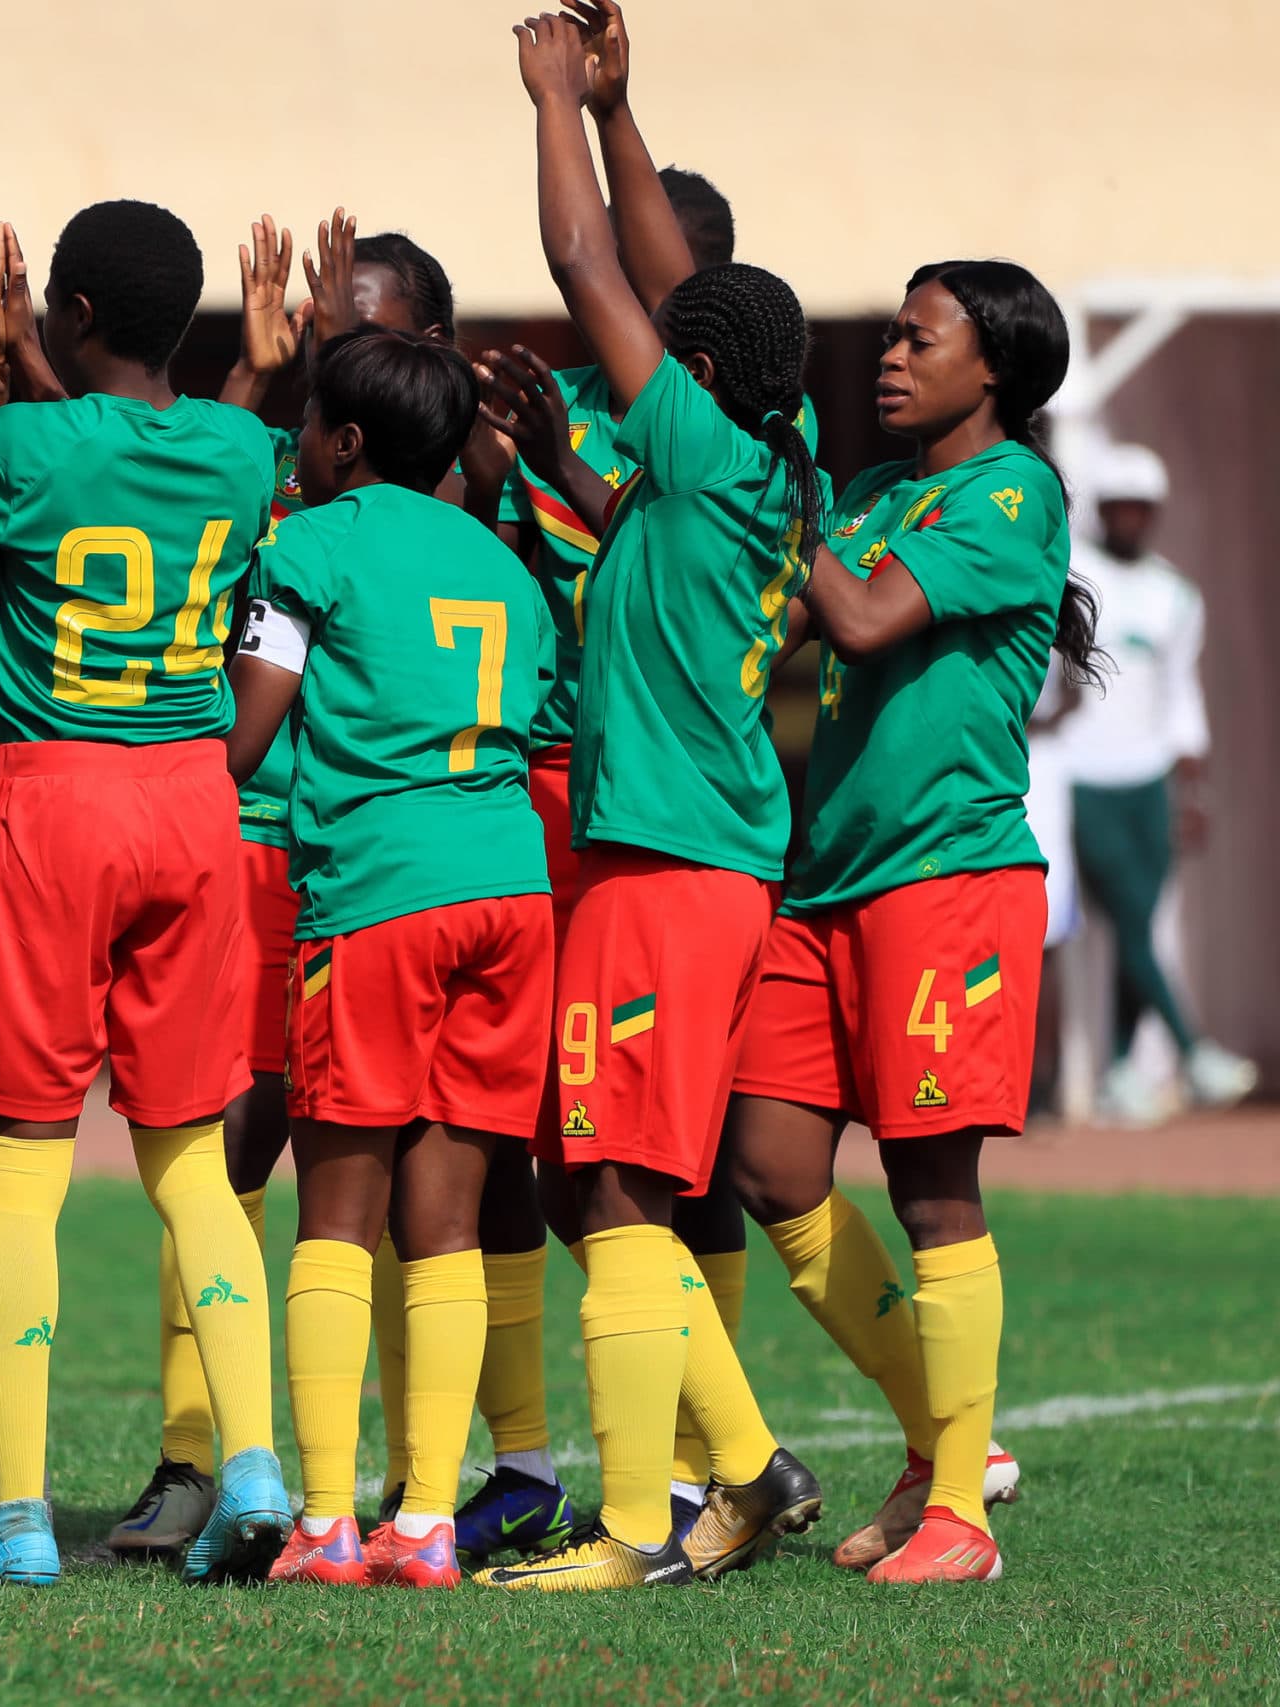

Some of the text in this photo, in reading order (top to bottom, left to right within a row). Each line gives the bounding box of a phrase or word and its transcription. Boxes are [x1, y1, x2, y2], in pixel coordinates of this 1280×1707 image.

[52, 520, 233, 706] 24
[429, 597, 507, 773] 7
[560, 1002, 597, 1086] 9
[906, 969, 953, 1053] 4
[283, 1546, 325, 1578] ULTRA
